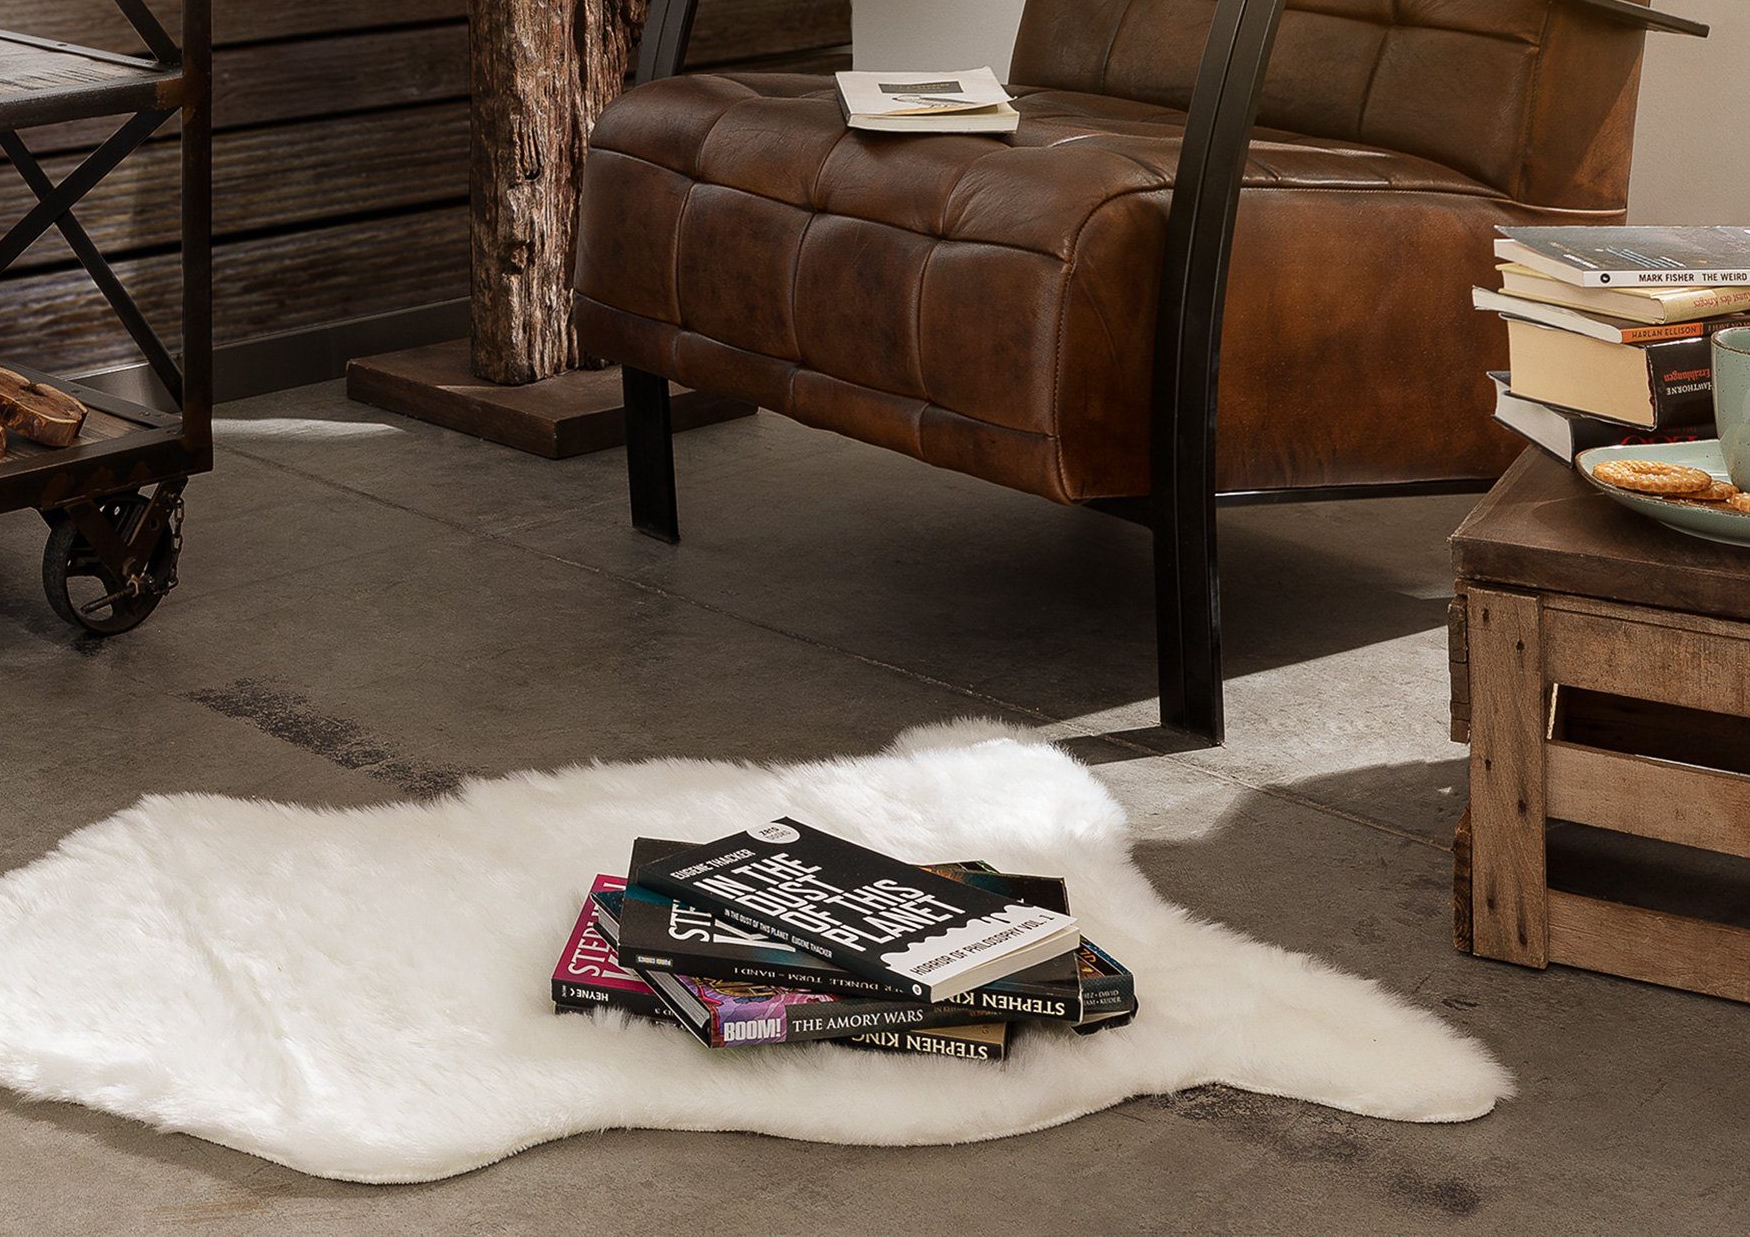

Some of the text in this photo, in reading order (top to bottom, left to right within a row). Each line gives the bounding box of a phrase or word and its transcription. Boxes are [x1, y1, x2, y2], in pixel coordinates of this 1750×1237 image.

[1638, 272, 1748, 282] MARK FISHER THE WEIRD
[1631, 326, 1697, 339] HARLAN ELLISON
[670, 848, 756, 880] EUGENE THACKER
[693, 852, 823, 900] IN THE
[734, 874, 845, 917] DUST
[779, 879, 925, 933] OF THIS
[724, 908, 833, 959] IN THE DUST OF THIS PLANET EUGENE THACKER
[820, 894, 966, 952] PLANET
[909, 955, 957, 976] HORROR
[950, 949, 969, 960] OF
[963, 926, 1025, 954] PHILOSOPHY
[1018, 918, 1048, 931] VOL.
[740, 967, 776, 979] BAND
[788, 972, 822, 984] TURM
[829, 977, 879, 991] DUNKLE
[576, 988, 609, 1002] HEYNE
[982, 992, 1066, 1016] STEPHEN
[723, 1018, 781, 1042] BOOM!
[792, 1018, 823, 1033] THE
[826, 1013, 880, 1030] AMORY
[882, 1009, 924, 1025] WARS
[906, 1035, 988, 1060] STEPHEN
